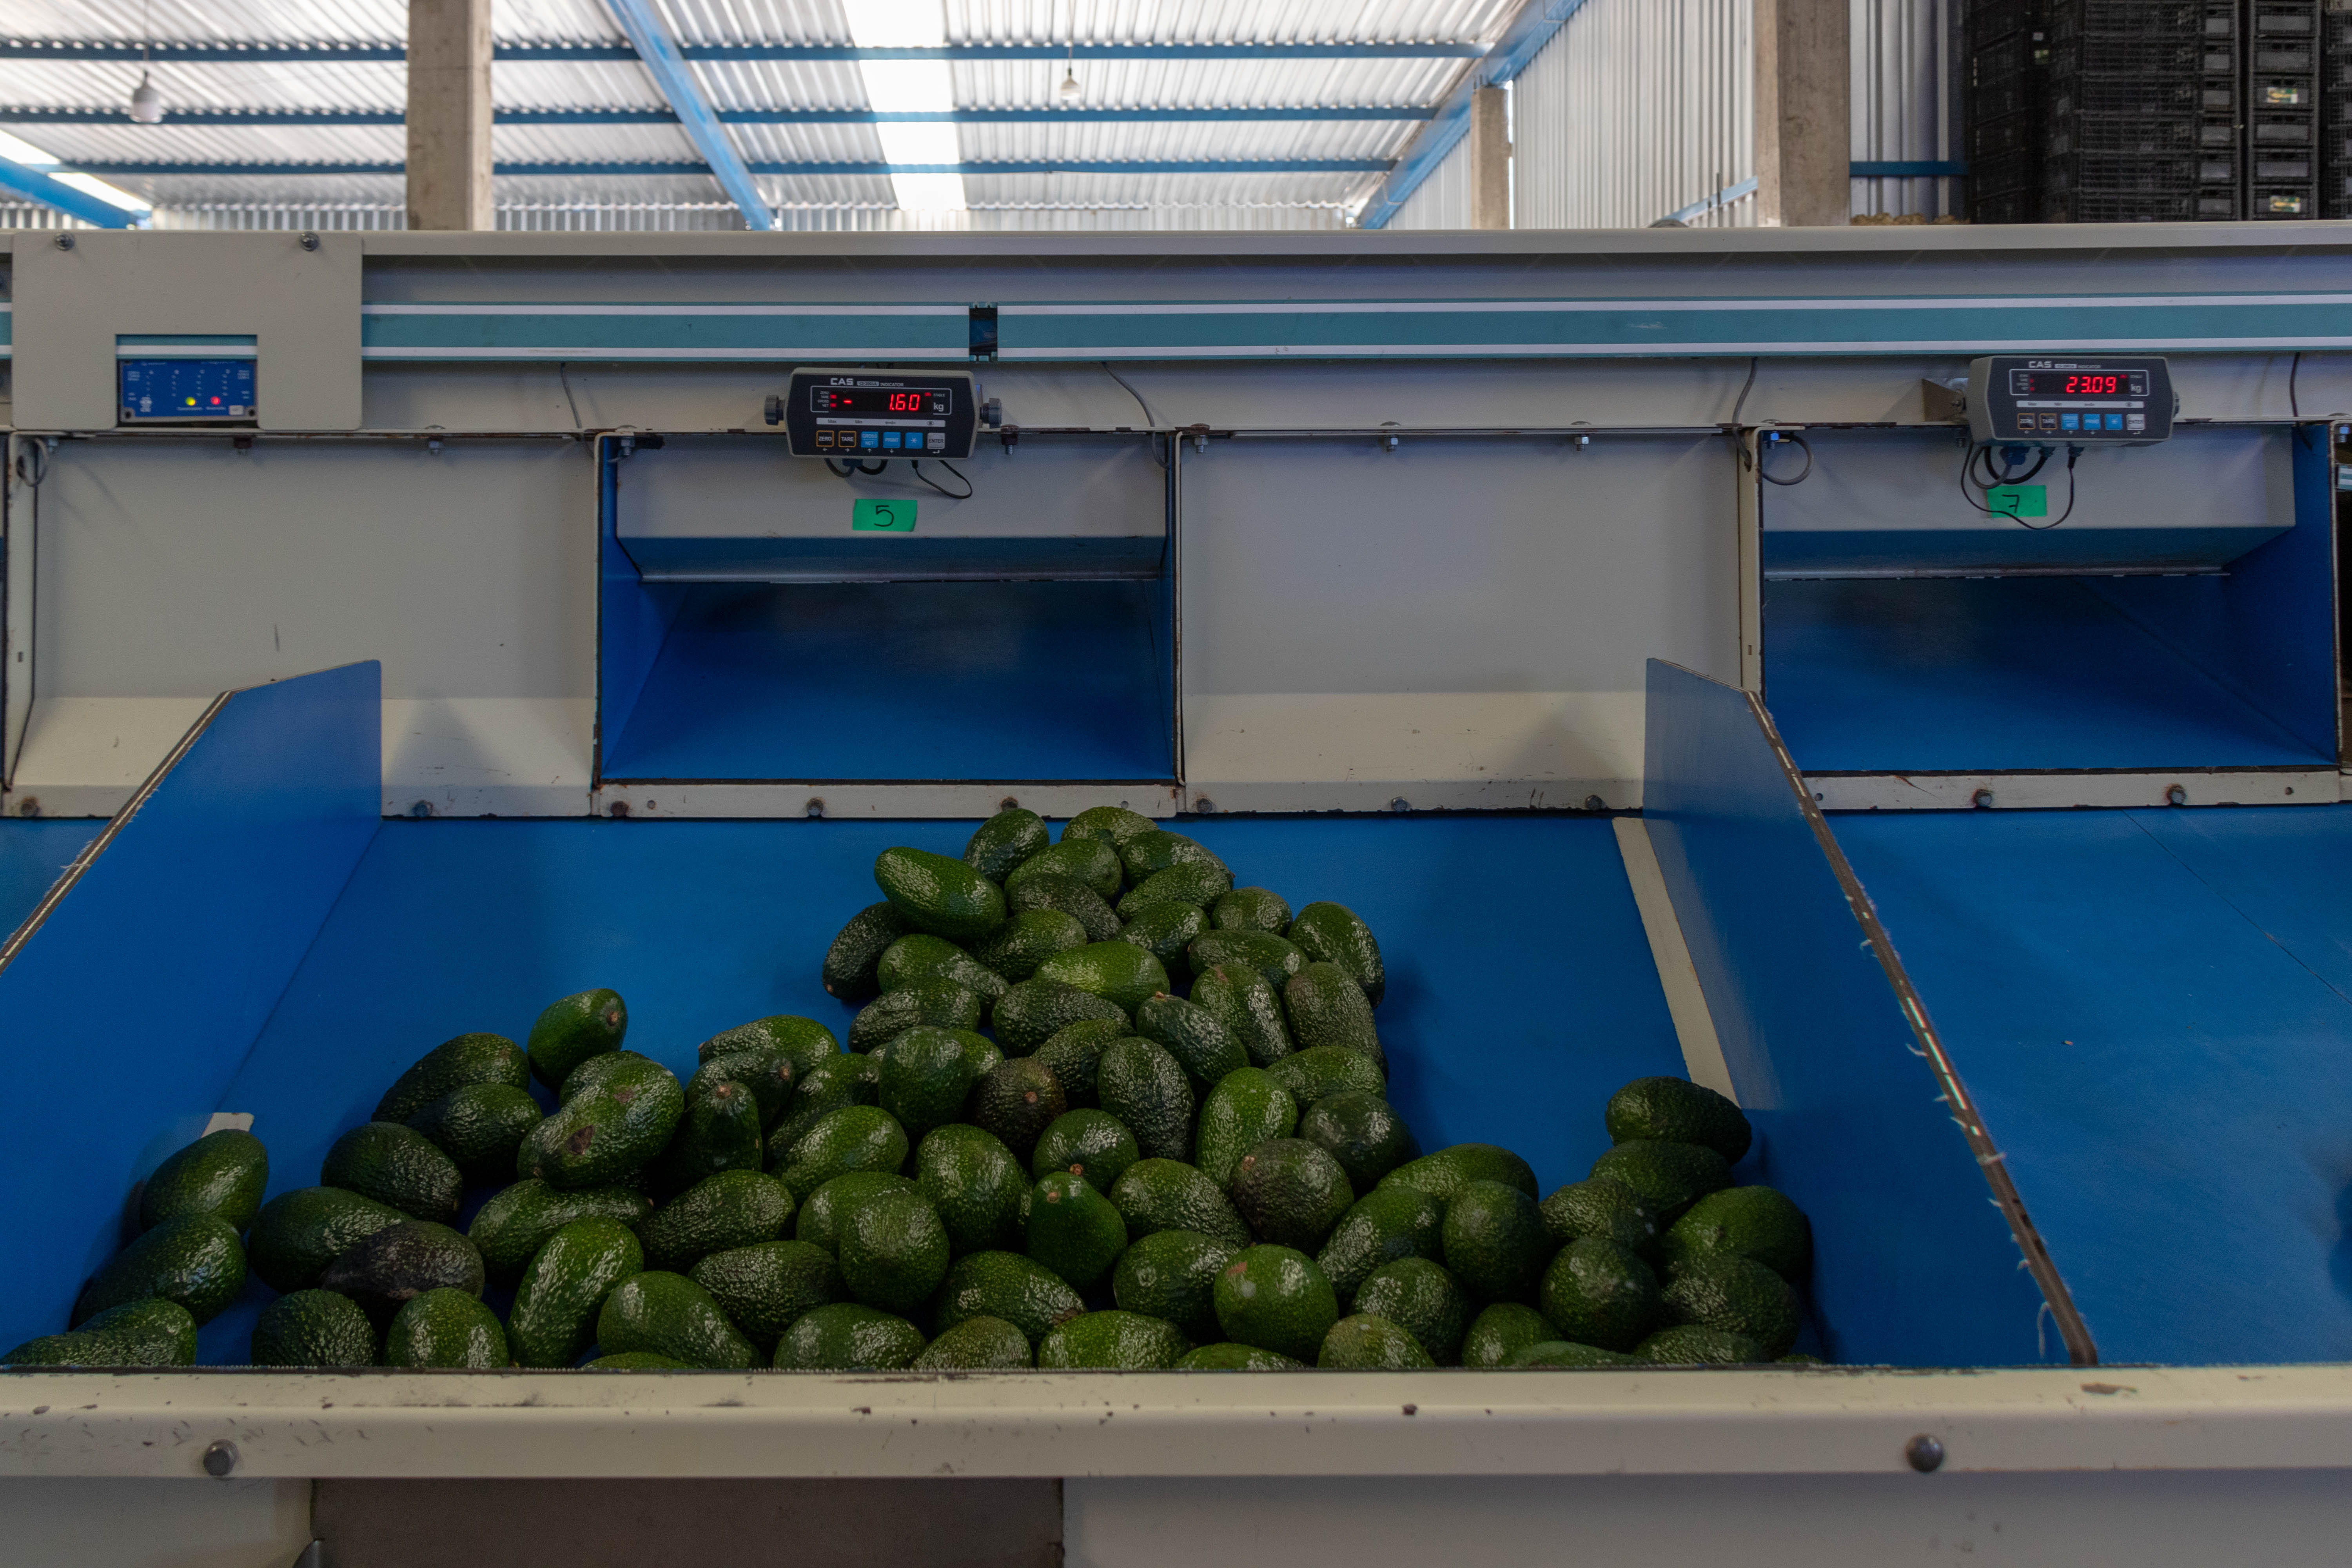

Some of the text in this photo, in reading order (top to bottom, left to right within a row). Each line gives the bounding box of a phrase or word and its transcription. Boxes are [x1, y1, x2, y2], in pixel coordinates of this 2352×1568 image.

[2065, 376, 2142, 394] 23.09 kg
[933, 402, 944, 412] kg
[2002, 494, 2020, 513] 7
[874, 505, 894, 527] 5
